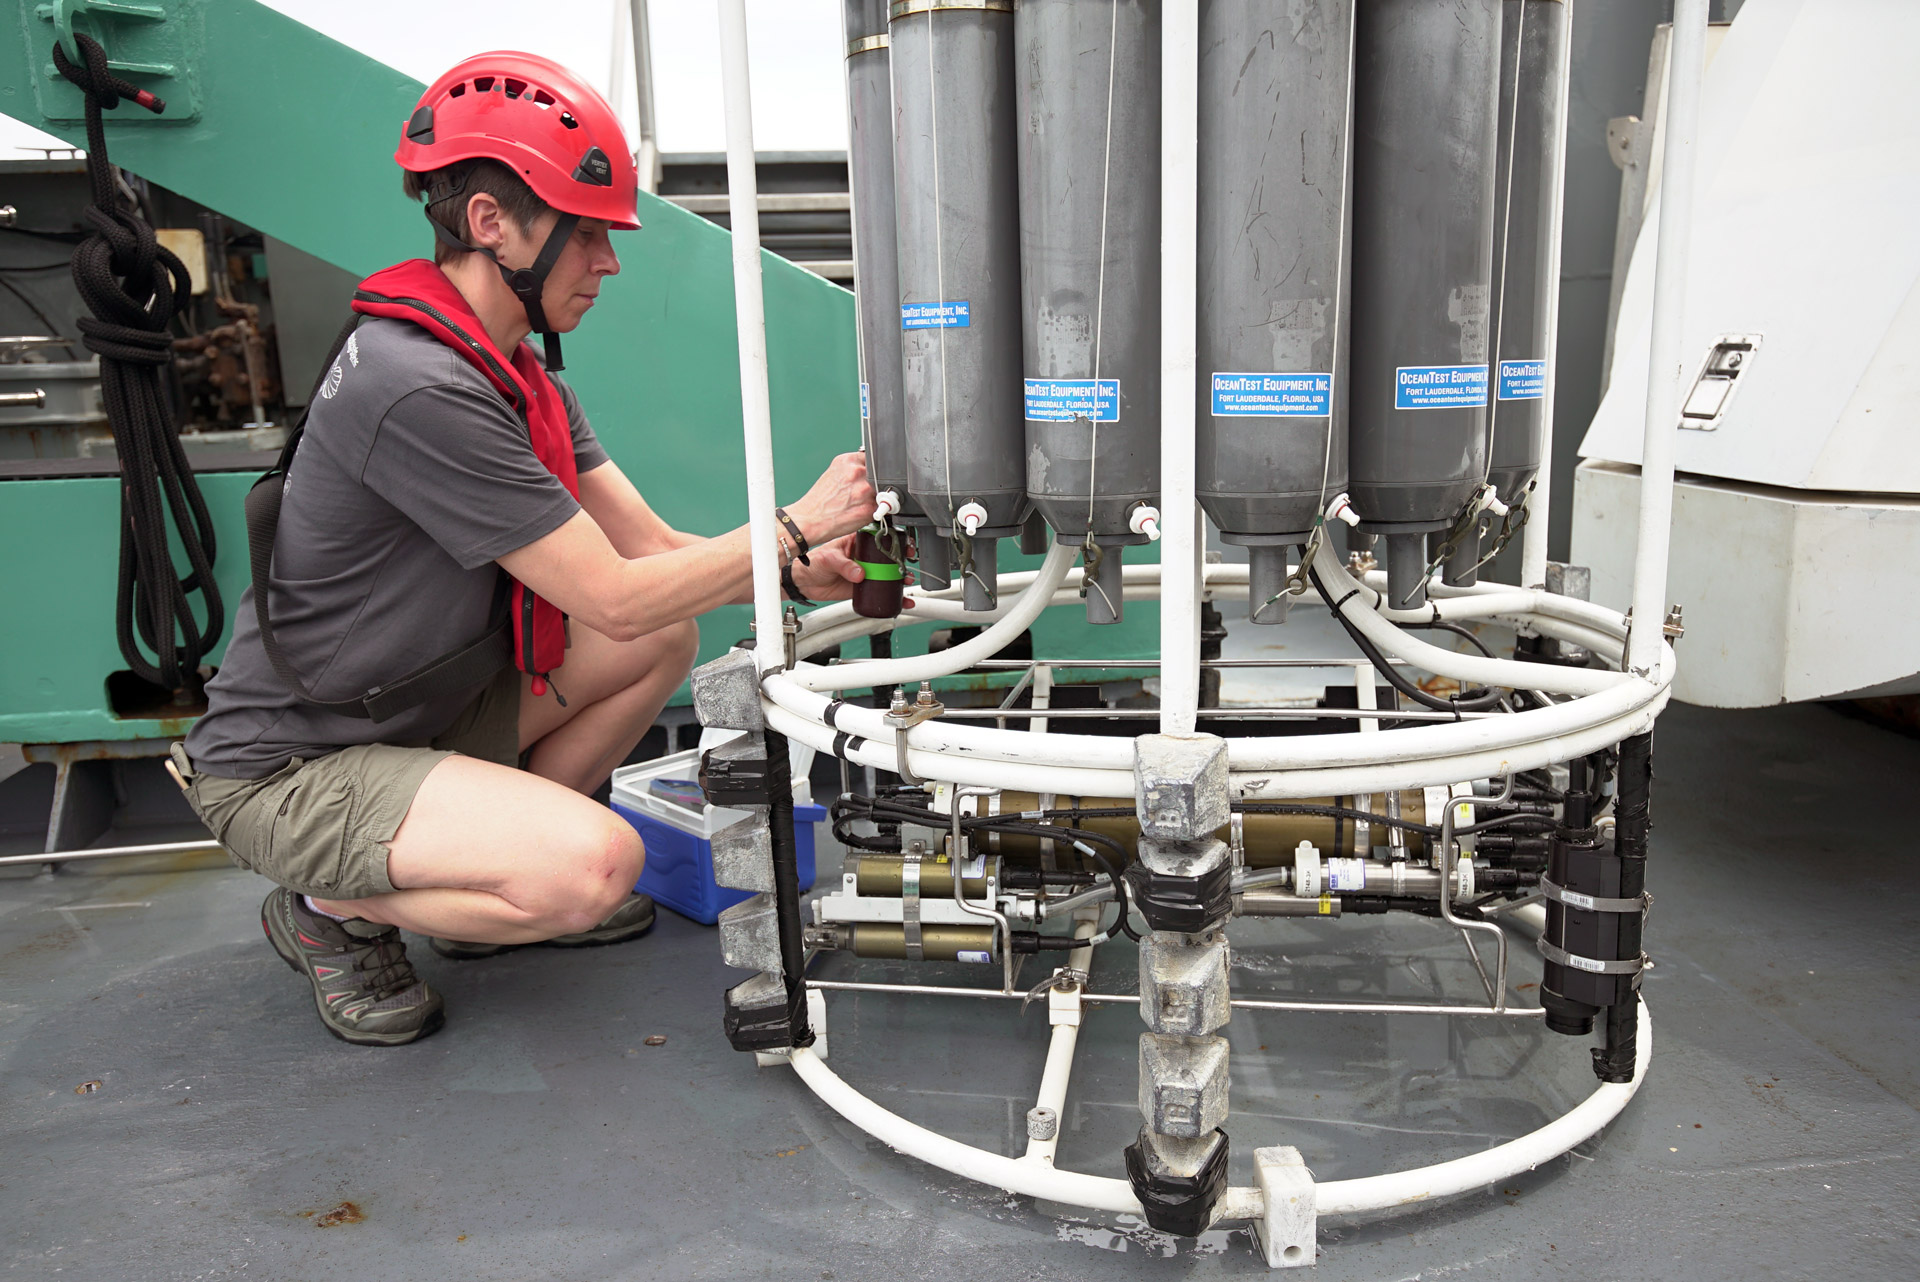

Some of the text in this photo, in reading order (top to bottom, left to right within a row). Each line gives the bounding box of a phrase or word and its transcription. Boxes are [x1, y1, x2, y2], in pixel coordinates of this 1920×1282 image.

[1405, 387, 1423, 396] FORT
[1219, 394, 1235, 402] FORT
[1235, 394, 1280, 403] LAUDERDALE,
[1282, 394, 1311, 403] FLORIDA,
